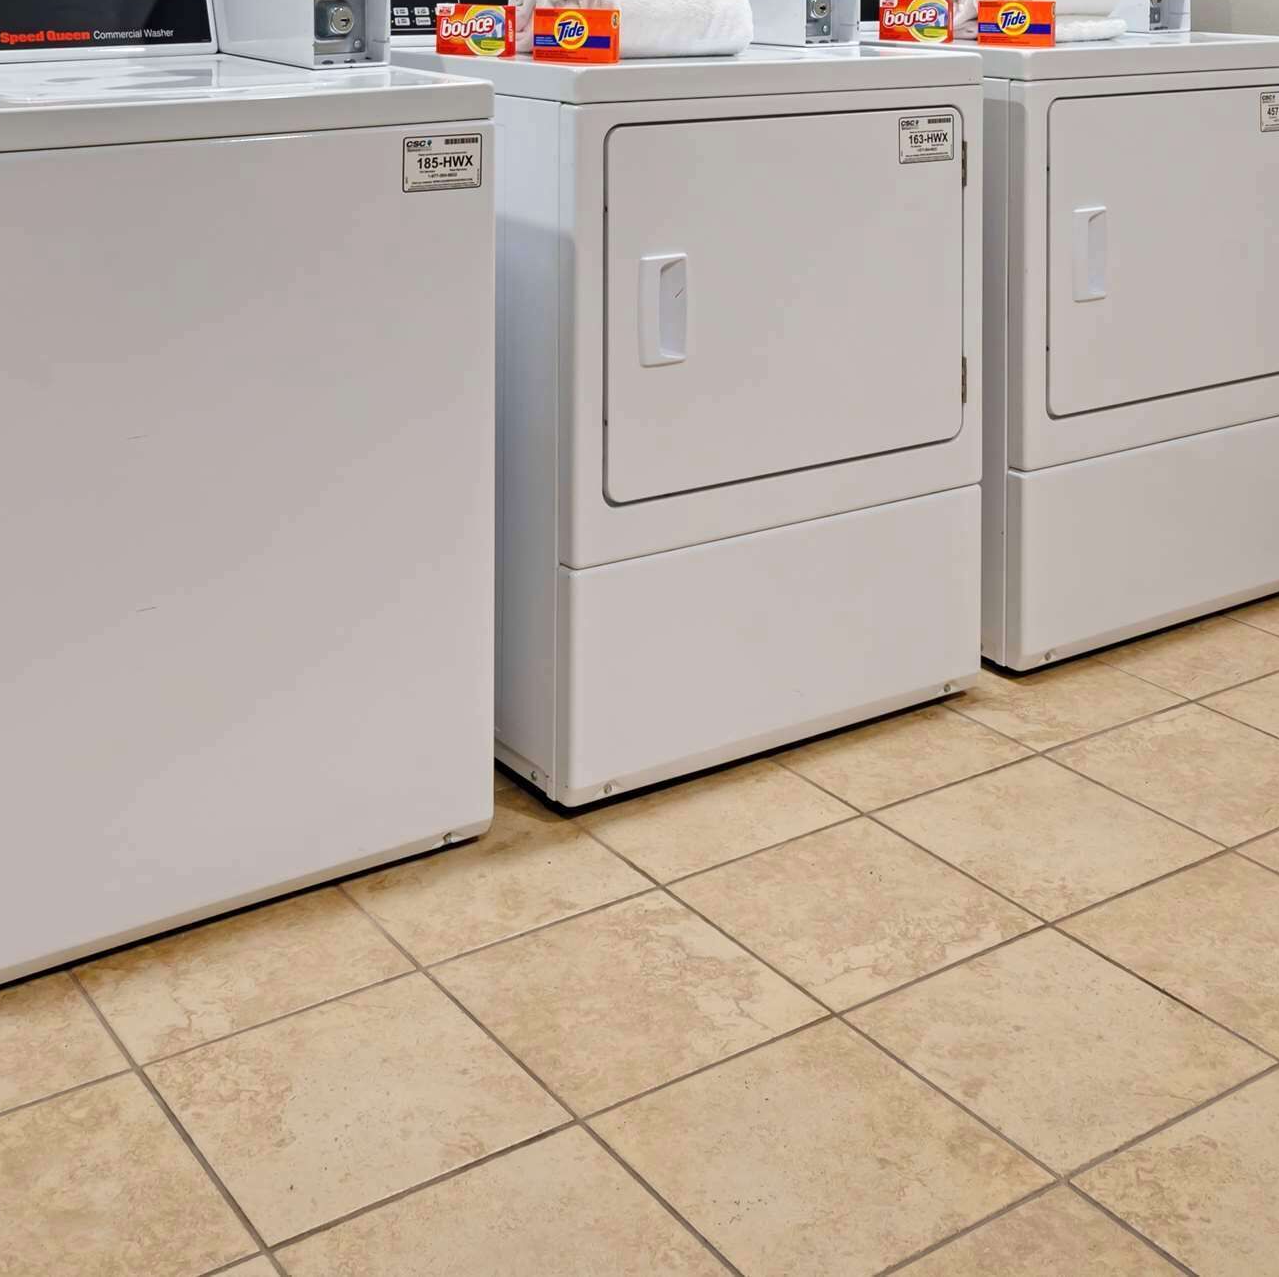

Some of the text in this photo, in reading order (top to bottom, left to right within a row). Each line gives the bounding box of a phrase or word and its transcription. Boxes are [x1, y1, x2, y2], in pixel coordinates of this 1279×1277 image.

[884, 8, 937, 27] bounce
[1000, 9, 1027, 29] Tide
[441, 15, 494, 38] bounce
[557, 21, 585, 42] Tide
[0, 28, 174, 44] Speed Queen Commercial Washer
[406, 140, 426, 148] CSC
[909, 132, 948, 144] 163-HWX
[417, 155, 473, 169] 185-HWX
